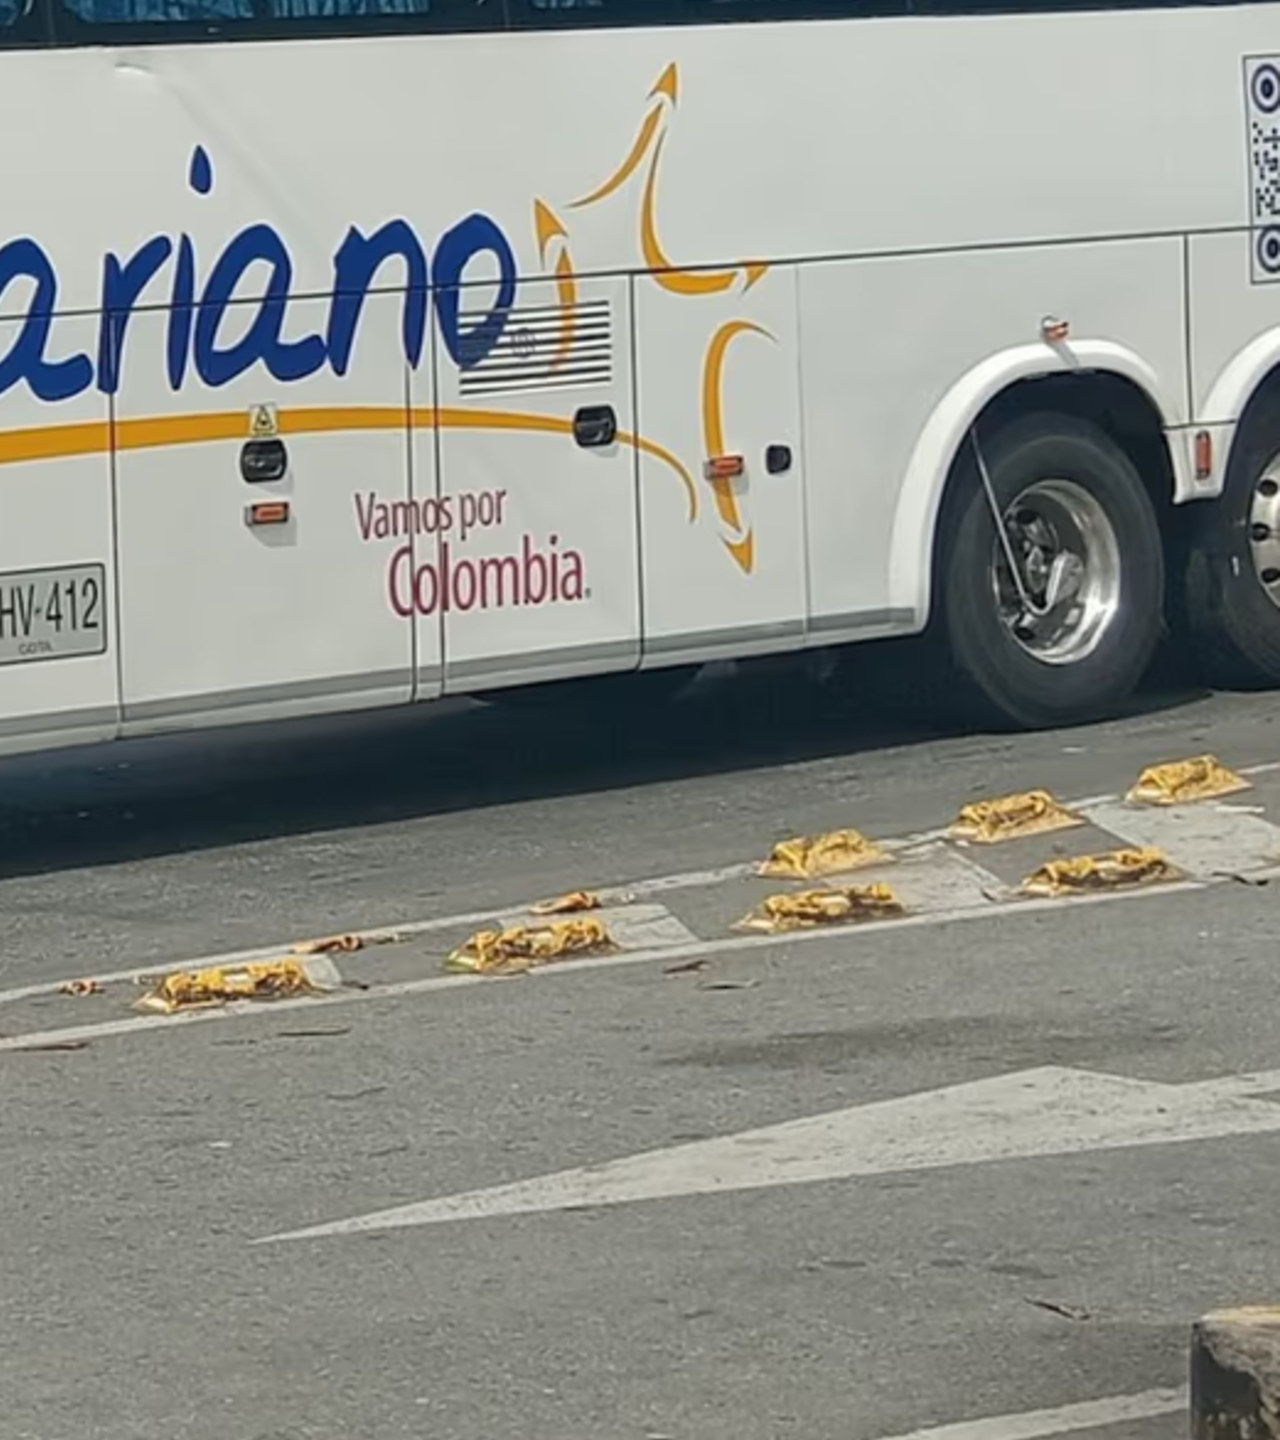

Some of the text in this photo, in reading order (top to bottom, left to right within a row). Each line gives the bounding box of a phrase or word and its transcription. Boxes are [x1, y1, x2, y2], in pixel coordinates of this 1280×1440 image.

[354, 490, 507, 541] Vamos por
[389, 534, 583, 617] Colombia
